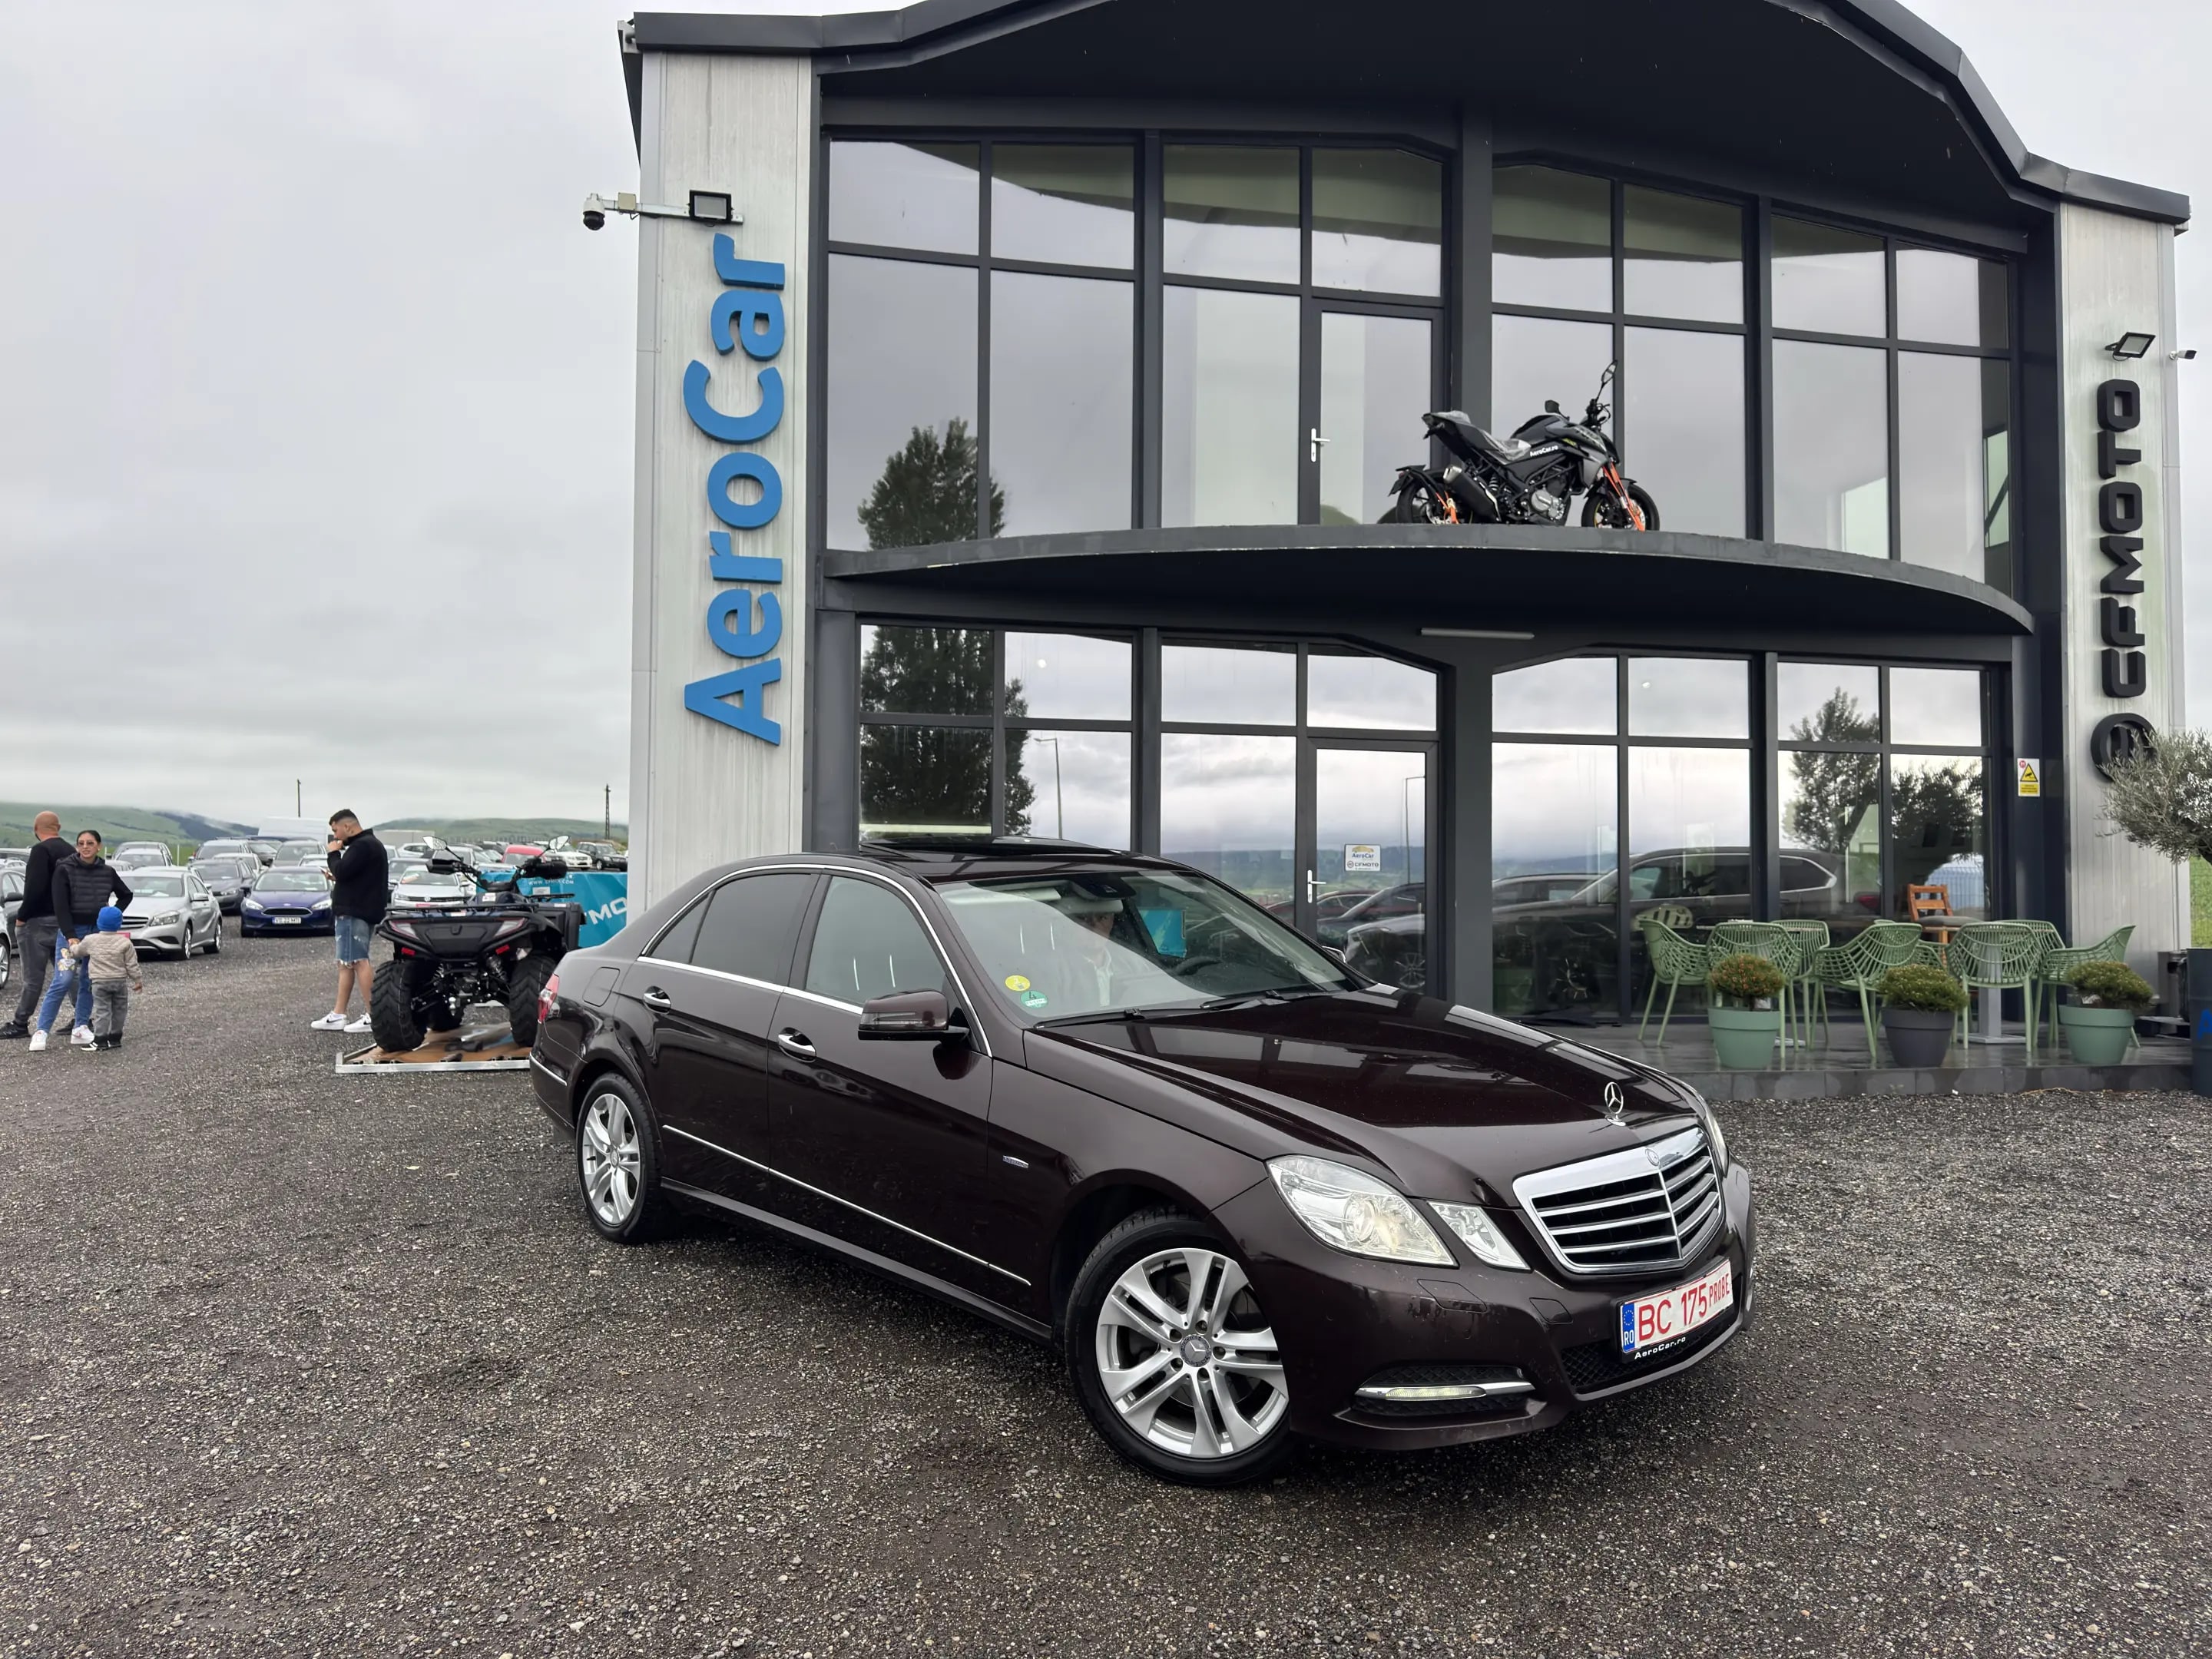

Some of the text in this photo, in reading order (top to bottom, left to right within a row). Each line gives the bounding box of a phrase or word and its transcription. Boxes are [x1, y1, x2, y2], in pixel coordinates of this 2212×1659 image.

[1529, 445, 1558, 457] AeroCar.ro
[683, 233, 785, 746] AeroCar
[2097, 379, 2146, 698] CFMOTO
[584, 897, 627, 925] MO
[1638, 1273, 1730, 1342] BC 175 PROBE
[1624, 1330, 1634, 1346] RO
[1634, 1336, 1686, 1359] AeroCar.ro
